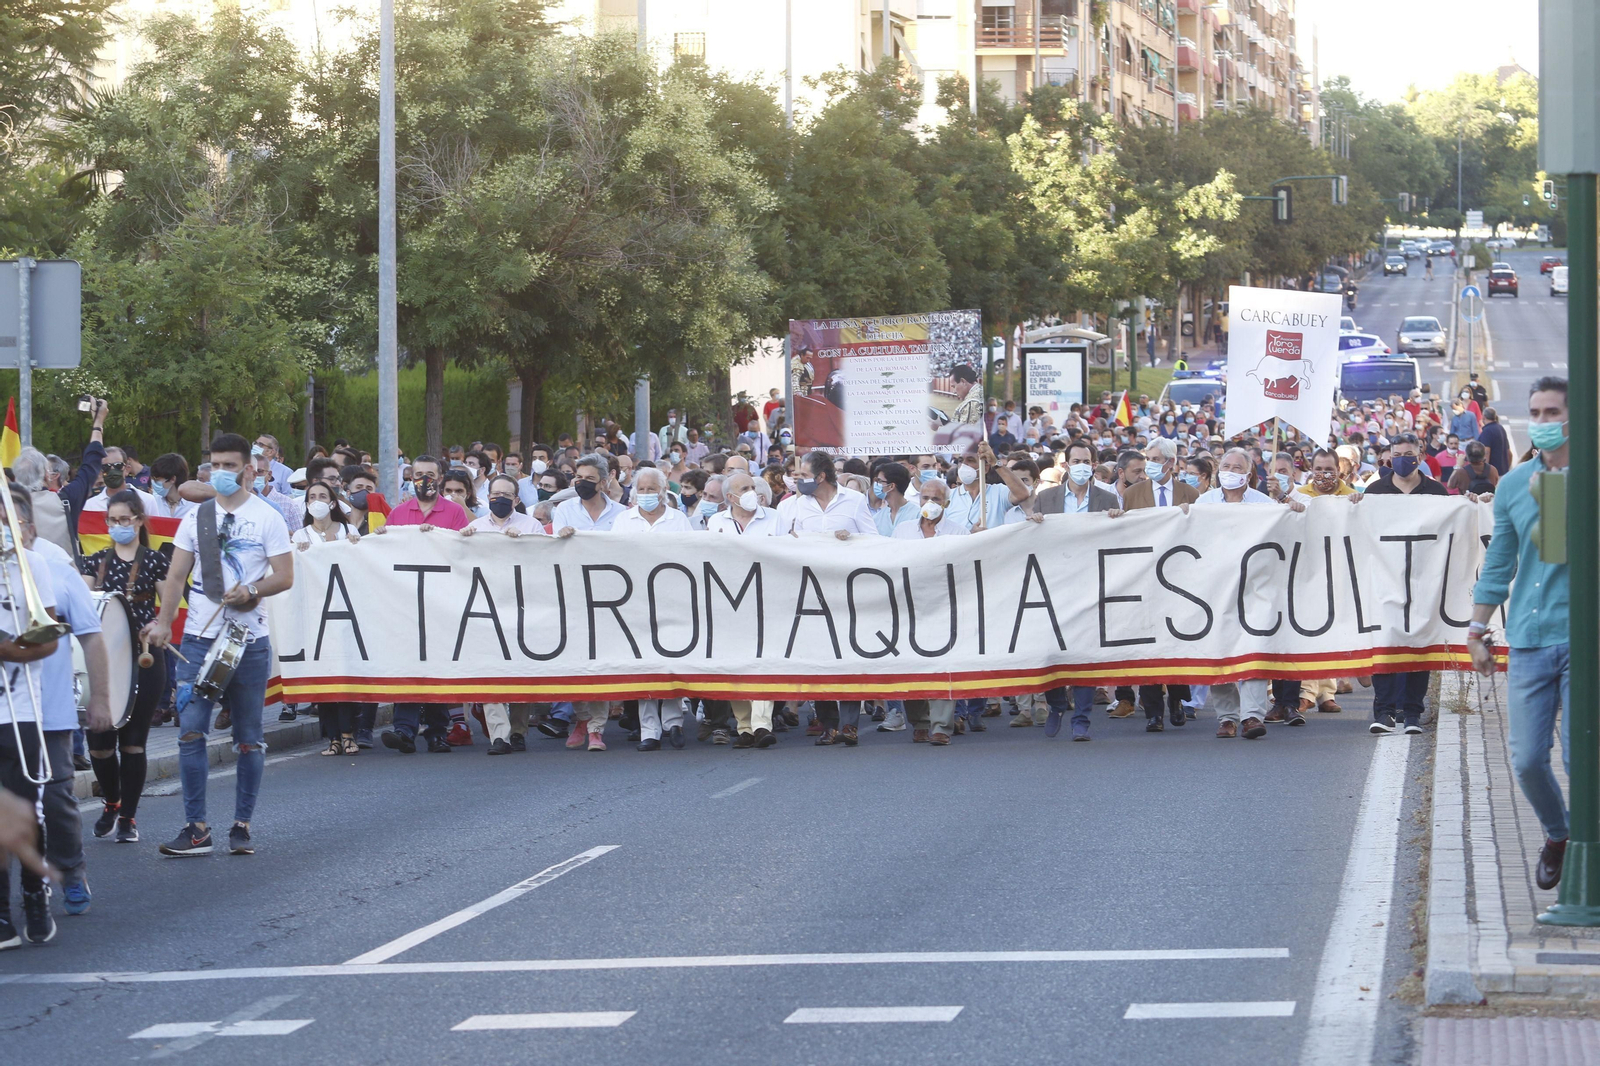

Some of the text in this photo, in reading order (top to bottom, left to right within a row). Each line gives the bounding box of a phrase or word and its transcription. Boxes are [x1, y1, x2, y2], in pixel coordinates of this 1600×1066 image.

[1240, 308, 1329, 328] CARCABUEY
[813, 321, 828, 331] LA
[866, 332, 880, 341] DE
[1269, 333, 1294, 348] Toro
[817, 343, 957, 358] CON LA CULTURA TAURINA
[1268, 341, 1301, 355] Cuerda
[1264, 390, 1298, 401] carcabuey
[838, 446, 881, 455] NUESTRA
[883, 445, 913, 454] FIESTA
[278, 563, 369, 662] A
[393, 553, 1067, 661] TAUROMAQUIA
[1099, 545, 1213, 648] ES
